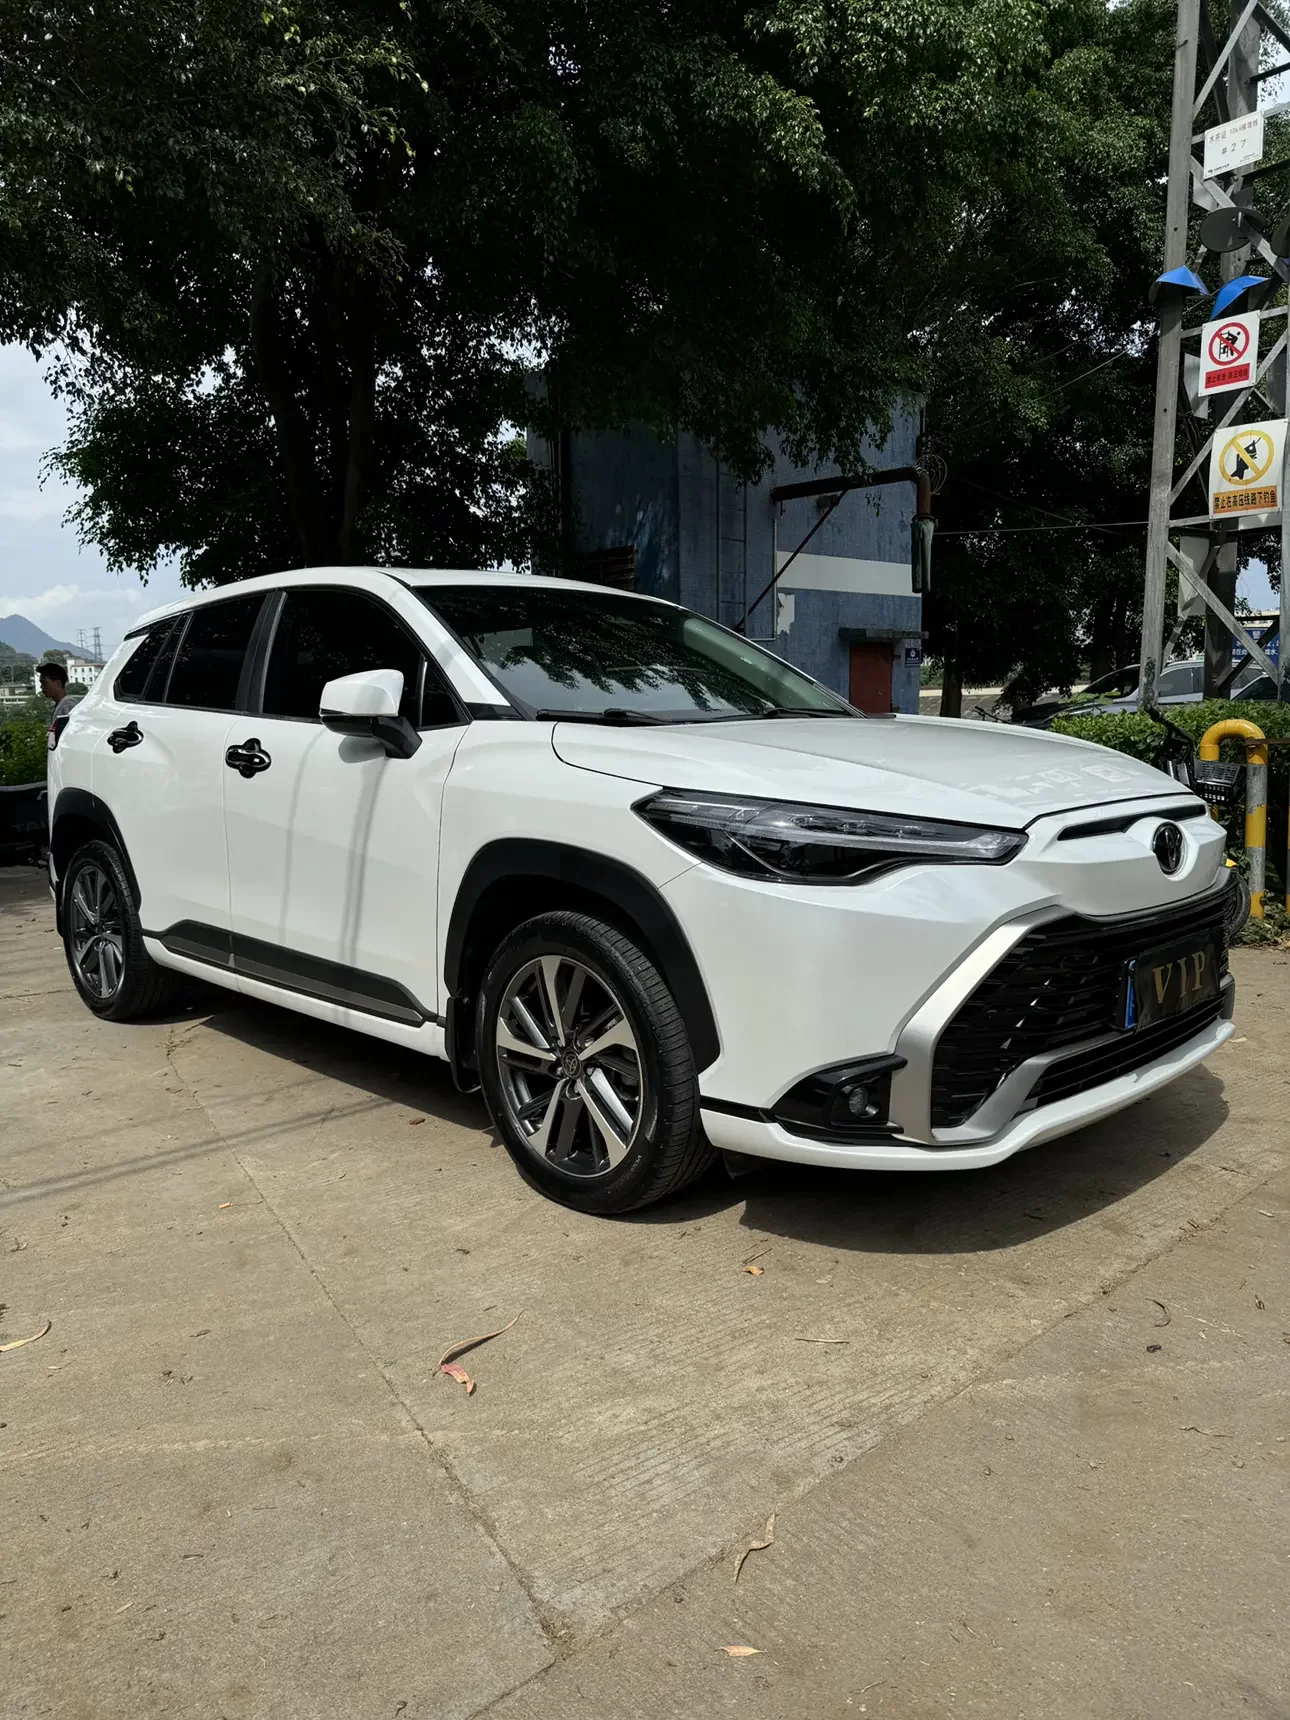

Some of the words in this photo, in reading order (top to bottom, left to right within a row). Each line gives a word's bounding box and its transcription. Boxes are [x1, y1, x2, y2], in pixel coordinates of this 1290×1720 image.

[1214, 489, 1277, 510] 禁止在高压线路下钓鱼
[1152, 950, 1206, 1004] VIP
